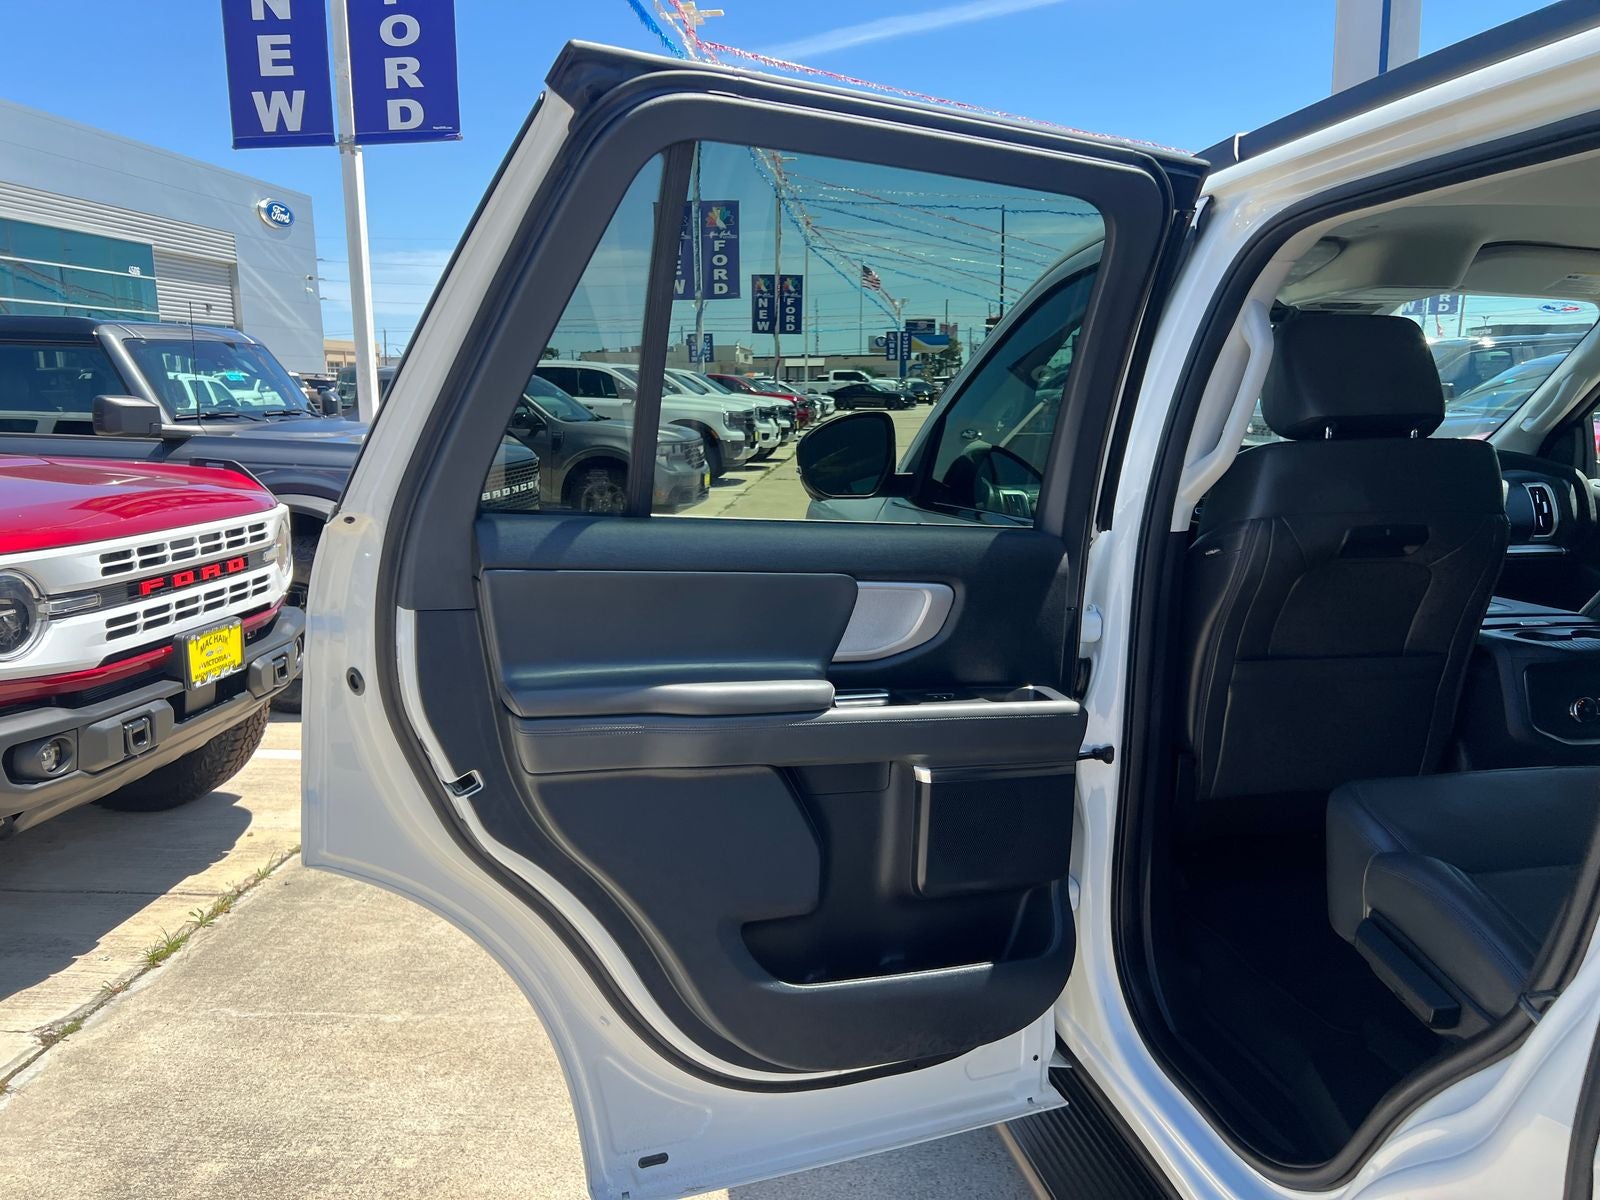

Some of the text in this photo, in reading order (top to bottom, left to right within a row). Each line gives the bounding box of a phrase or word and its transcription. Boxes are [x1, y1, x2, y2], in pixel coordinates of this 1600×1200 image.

[379, 0, 425, 131] ORD
[271, 204, 291, 224] Ford
[712, 240, 728, 295] FORD
[756, 298, 770, 331] NEW
[785, 298, 796, 331] FORD
[481, 481, 535, 501] BRONCO
[139, 556, 245, 596] FORD
